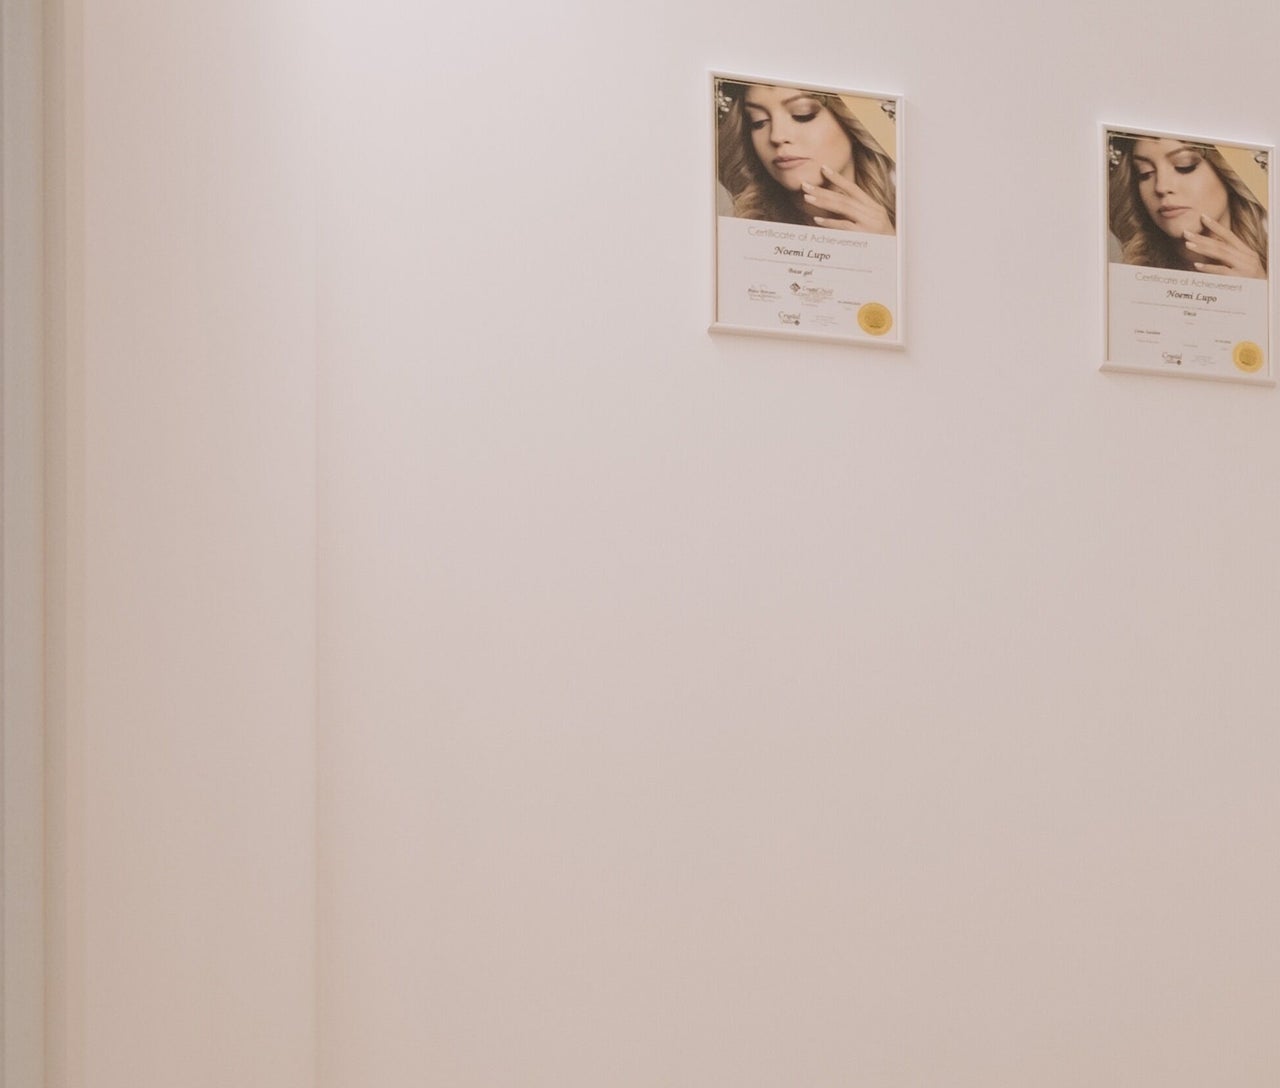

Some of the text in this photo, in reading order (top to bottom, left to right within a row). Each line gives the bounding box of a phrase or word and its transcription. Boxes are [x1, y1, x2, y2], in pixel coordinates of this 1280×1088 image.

[747, 226, 869, 248] Certificate of Achievement
[774, 246, 831, 262] Noemi Lupo
[1134, 272, 1242, 292] Certificate of Achievement
[1166, 290, 1217, 304] Noemi Lupo
